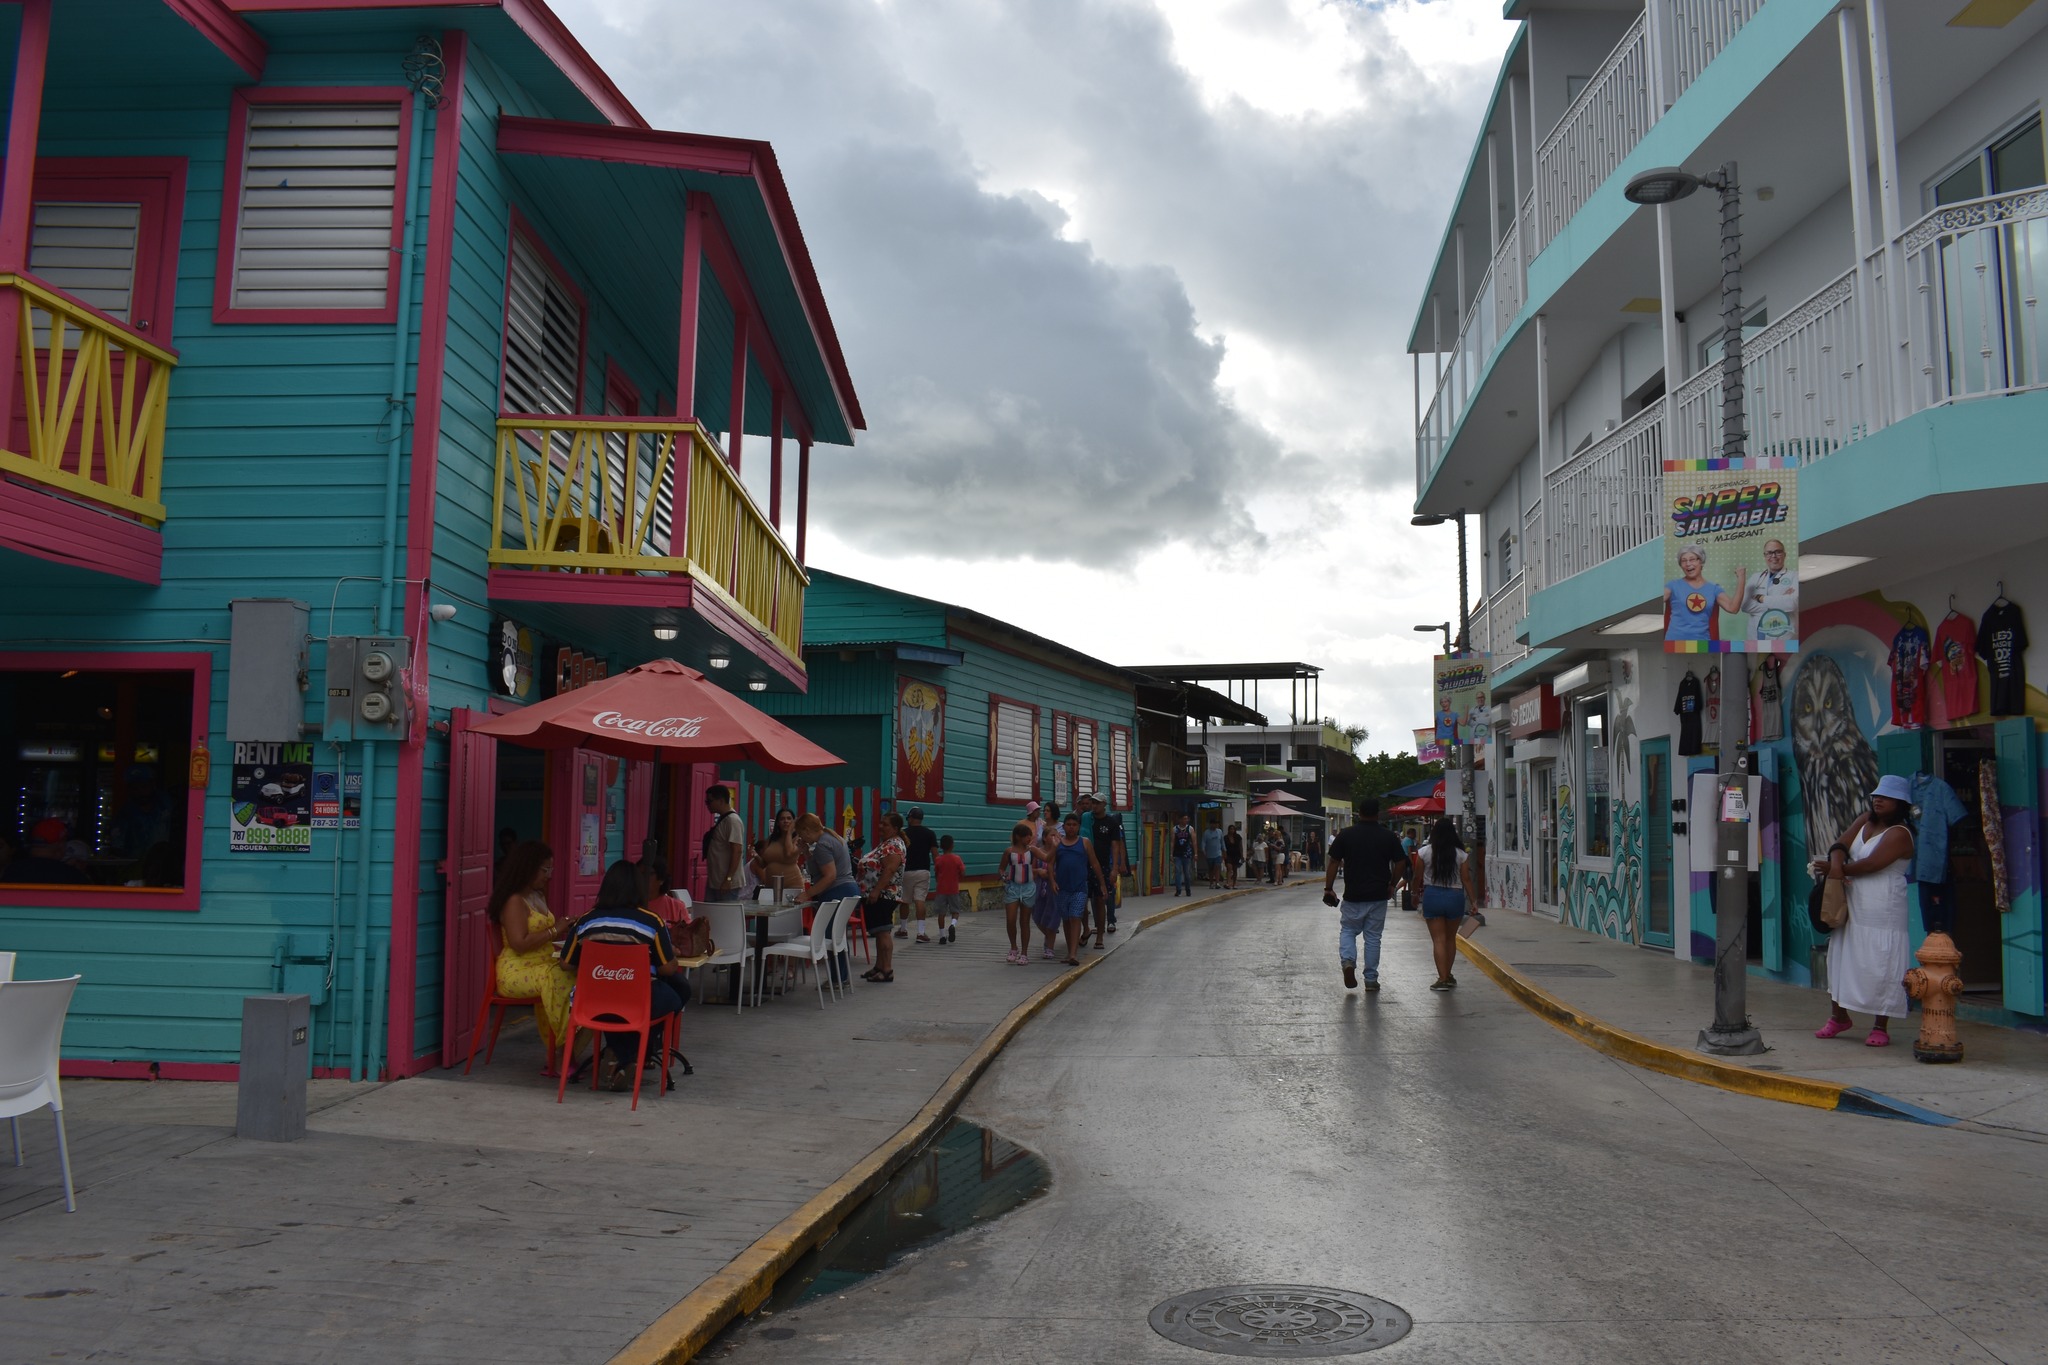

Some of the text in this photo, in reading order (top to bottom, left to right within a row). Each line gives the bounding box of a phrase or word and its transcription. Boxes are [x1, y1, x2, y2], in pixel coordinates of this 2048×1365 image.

[1710, 479, 1751, 489] QUEREMOS
[1672, 482, 1782, 521] SUPER
[1674, 504, 1789, 539] SALUDABLE
[1696, 528, 1766, 546] EN MIGRANT
[1438, 675, 1487, 692] SALUDABLE
[592, 711, 709, 738] Coca-Cola
[234, 742, 313, 765] RENT ME
[232, 831, 245, 841] 787
[592, 965, 635, 981] Coca-Cola
[1226, 1302, 1303, 1315] SEWER
